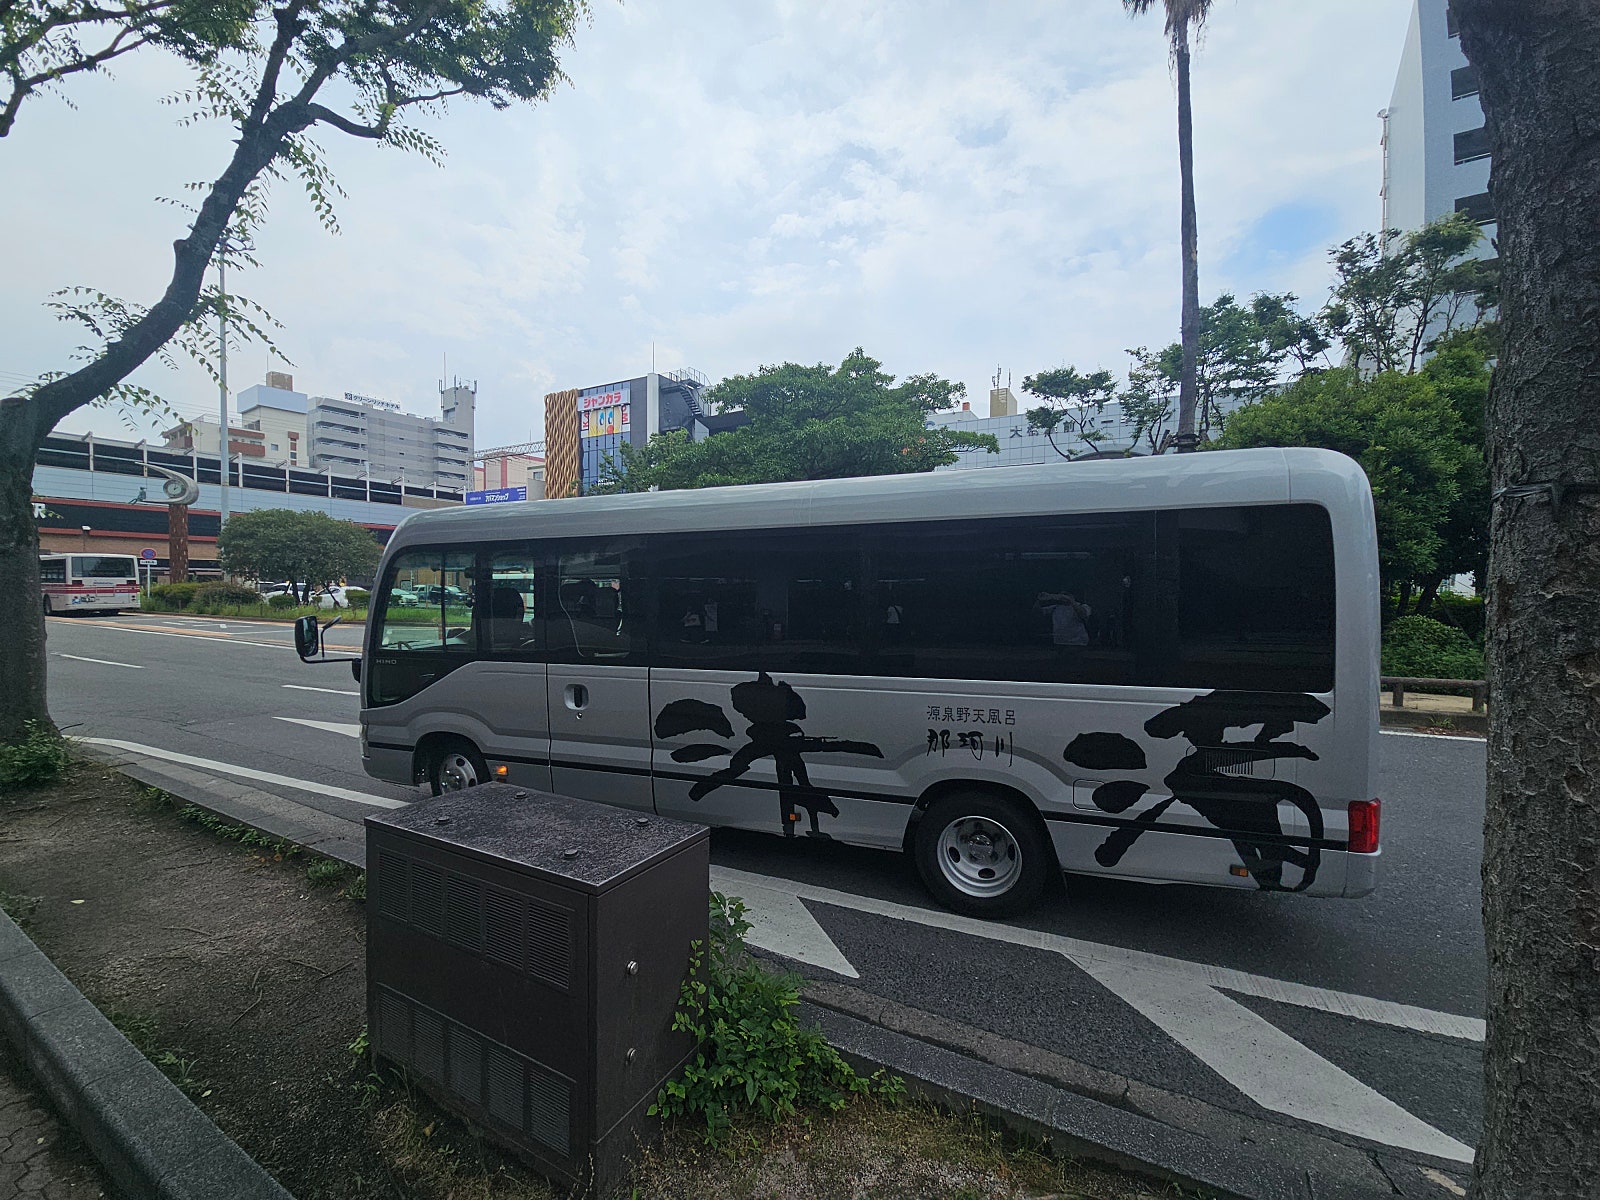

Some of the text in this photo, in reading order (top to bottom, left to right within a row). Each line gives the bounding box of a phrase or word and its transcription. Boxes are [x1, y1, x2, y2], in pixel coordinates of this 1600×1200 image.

[584, 391, 622, 409] ジャンカラ
[926, 705, 1016, 726] 源泉野天風呂
[926, 728, 1013, 768] 那珂川
